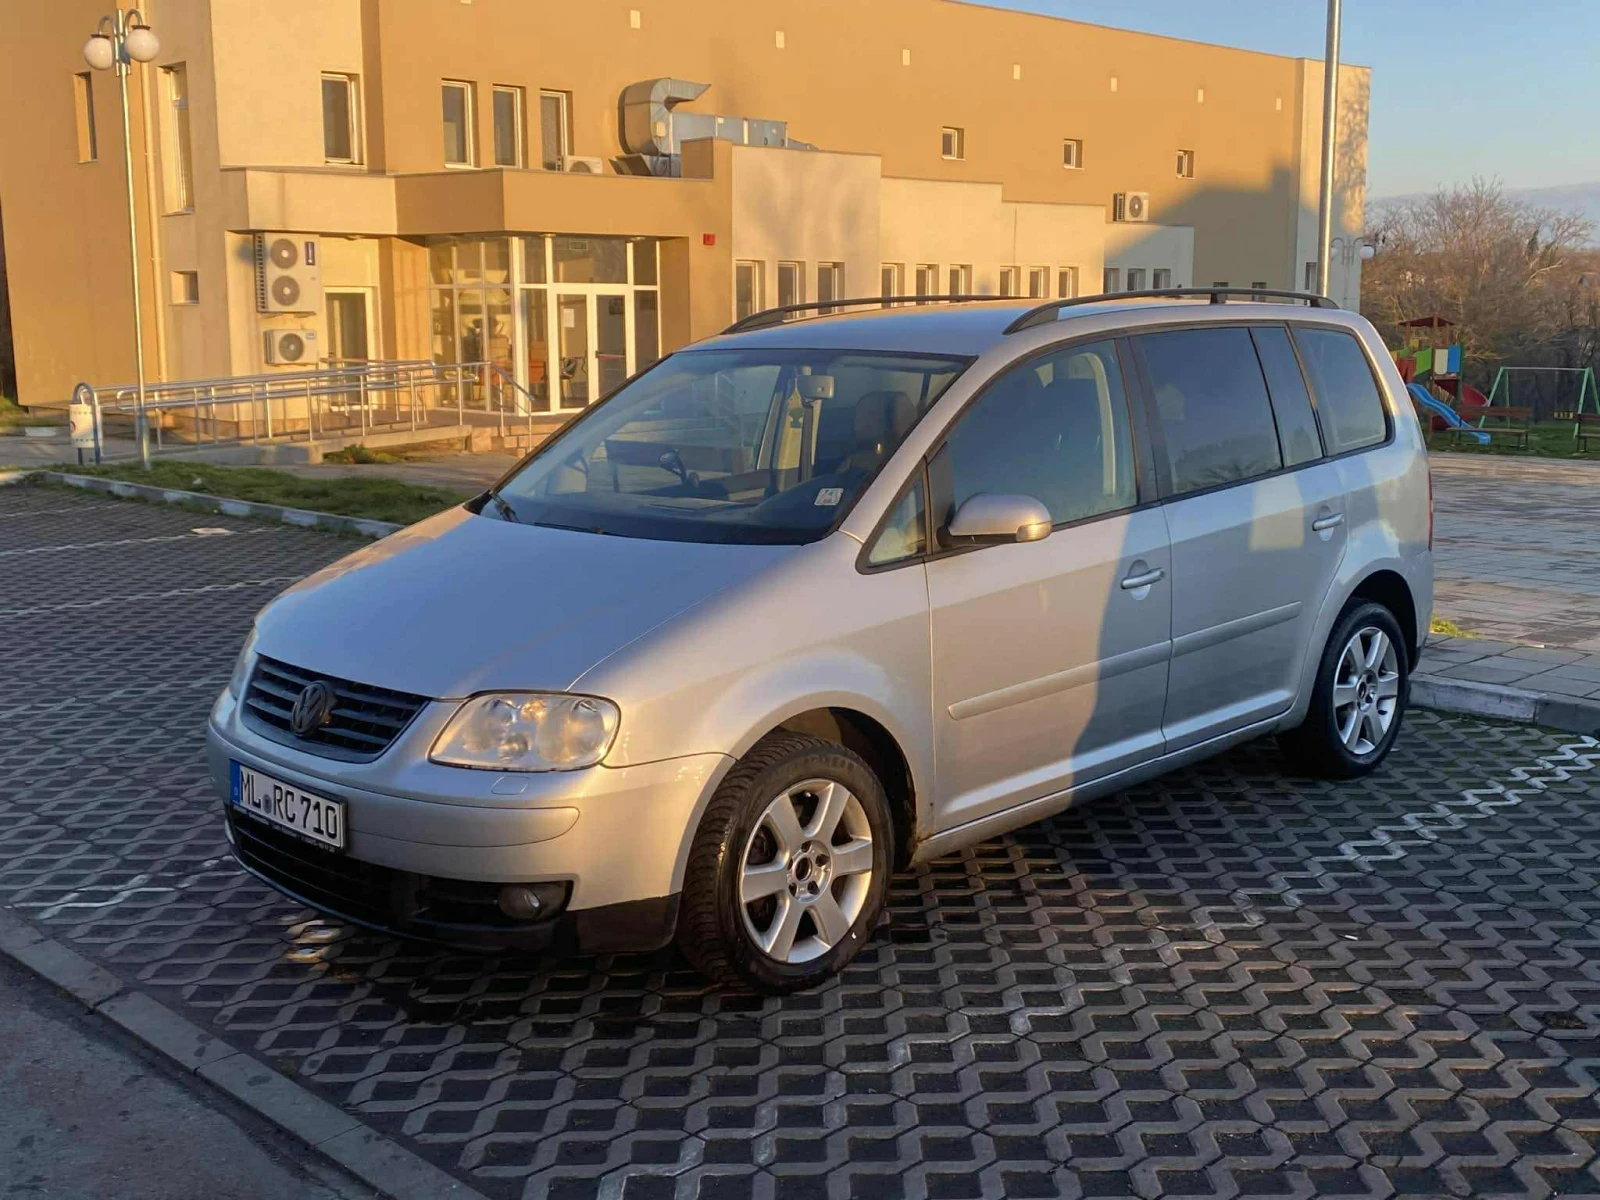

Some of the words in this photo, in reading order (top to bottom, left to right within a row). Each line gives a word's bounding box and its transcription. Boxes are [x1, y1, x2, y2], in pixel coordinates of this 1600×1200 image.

[241, 770, 261, 808] ML
[274, 784, 296, 823] RC
[301, 795, 338, 840] 710
